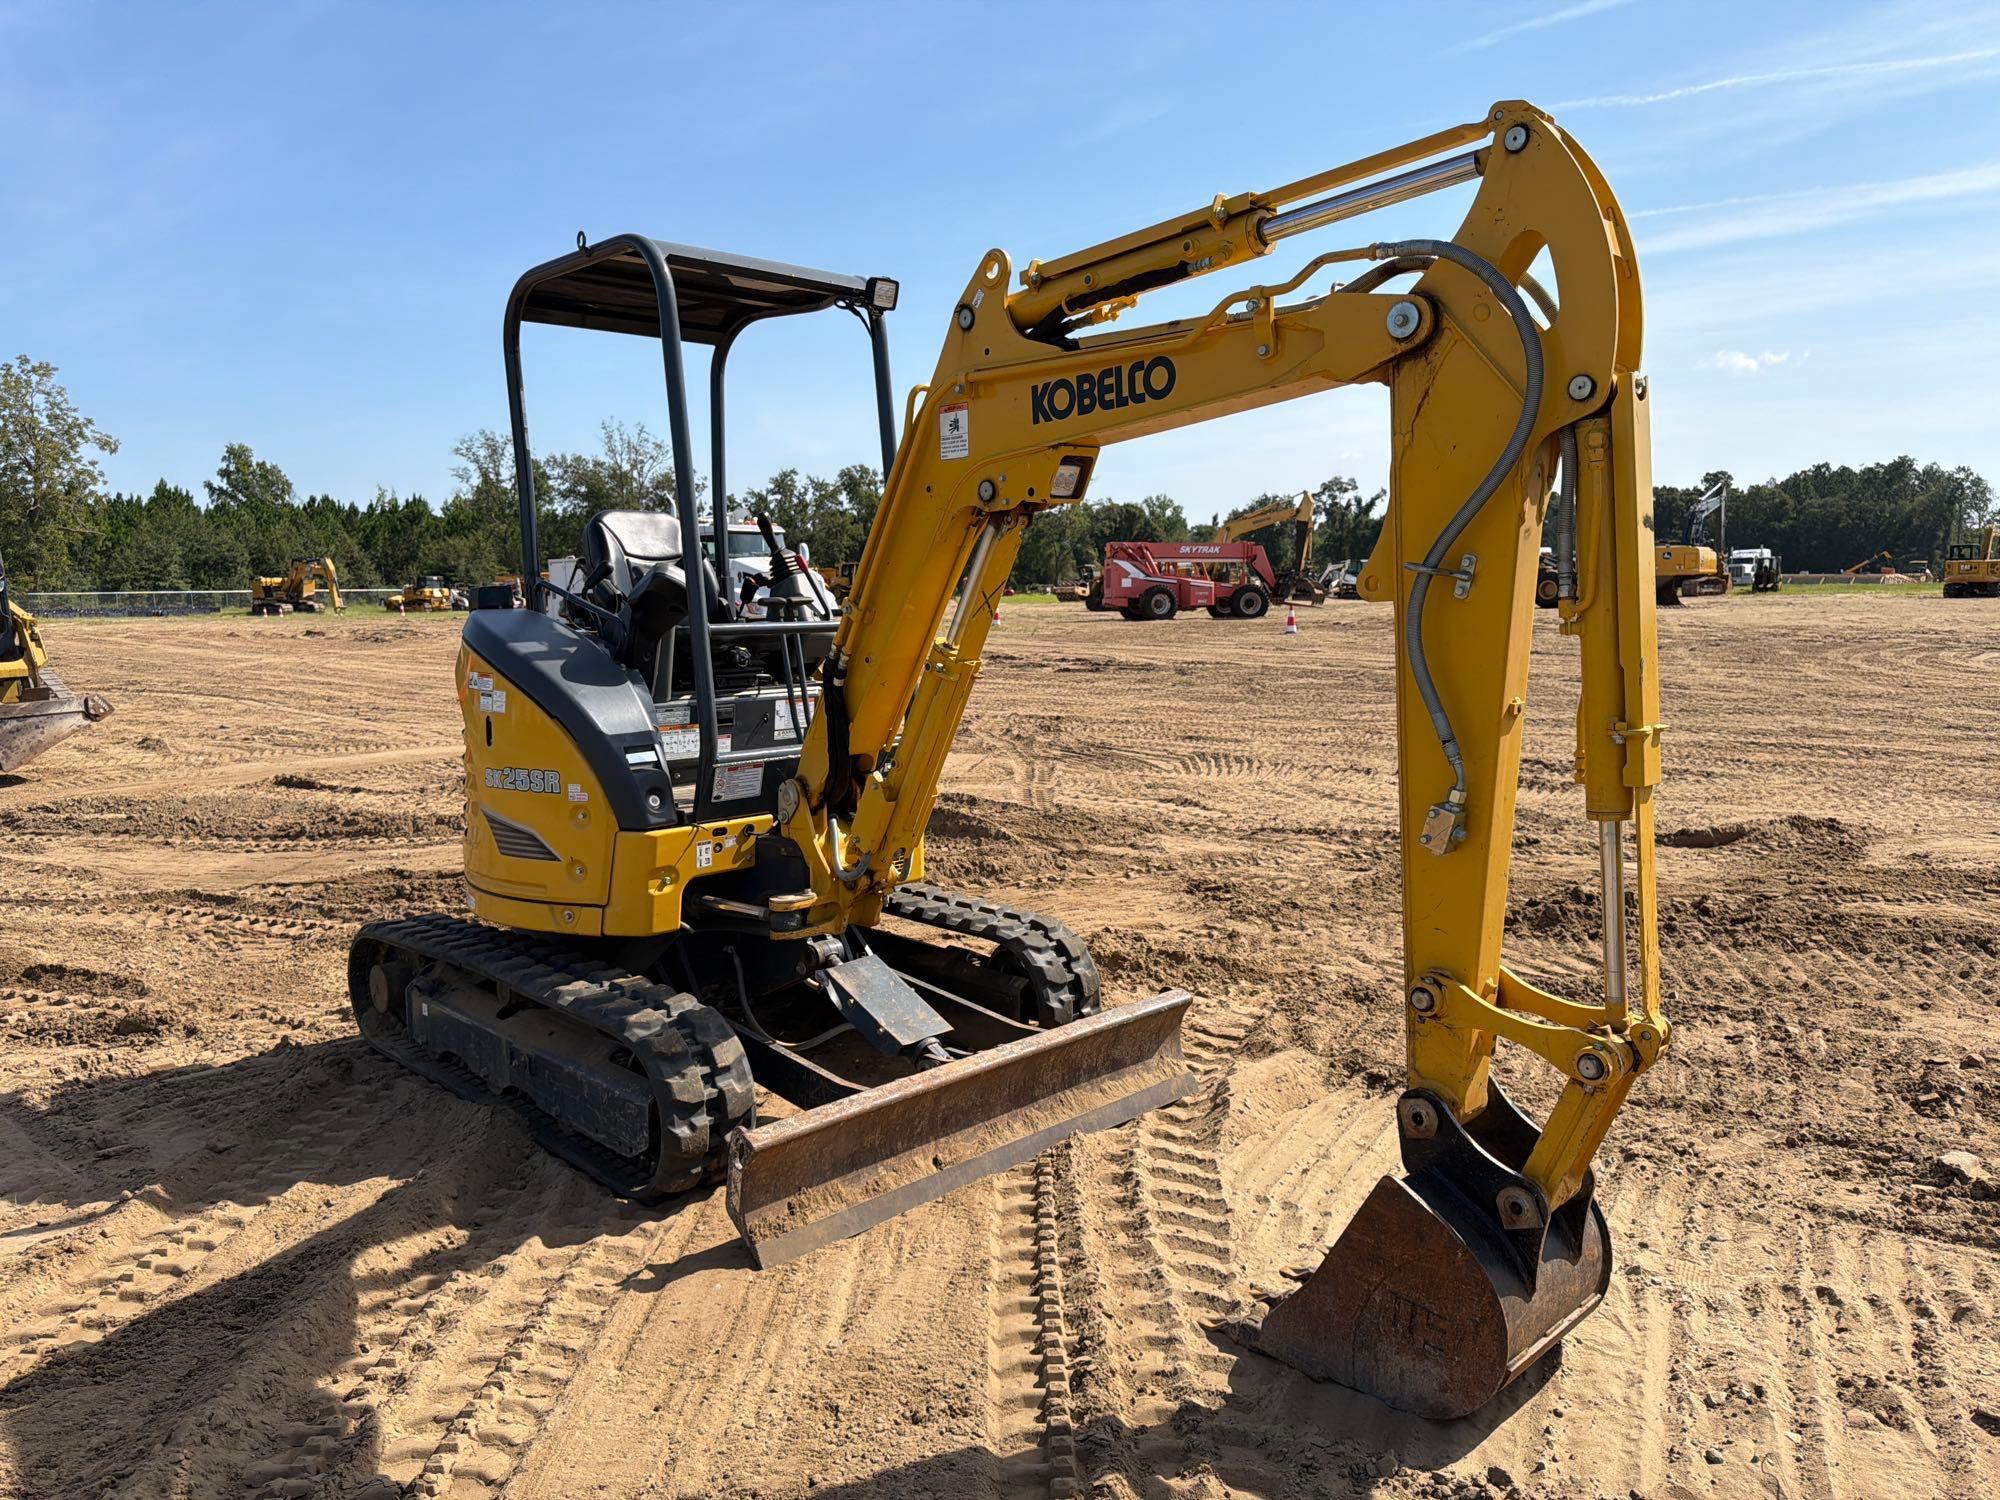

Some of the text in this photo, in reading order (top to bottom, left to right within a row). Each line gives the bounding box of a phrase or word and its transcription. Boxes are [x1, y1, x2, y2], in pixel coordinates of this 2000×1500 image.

[1031, 356, 1177, 425] KOBELCO
[1179, 545, 1221, 554] SKYTRAK
[485, 767, 561, 794] SK25SR
